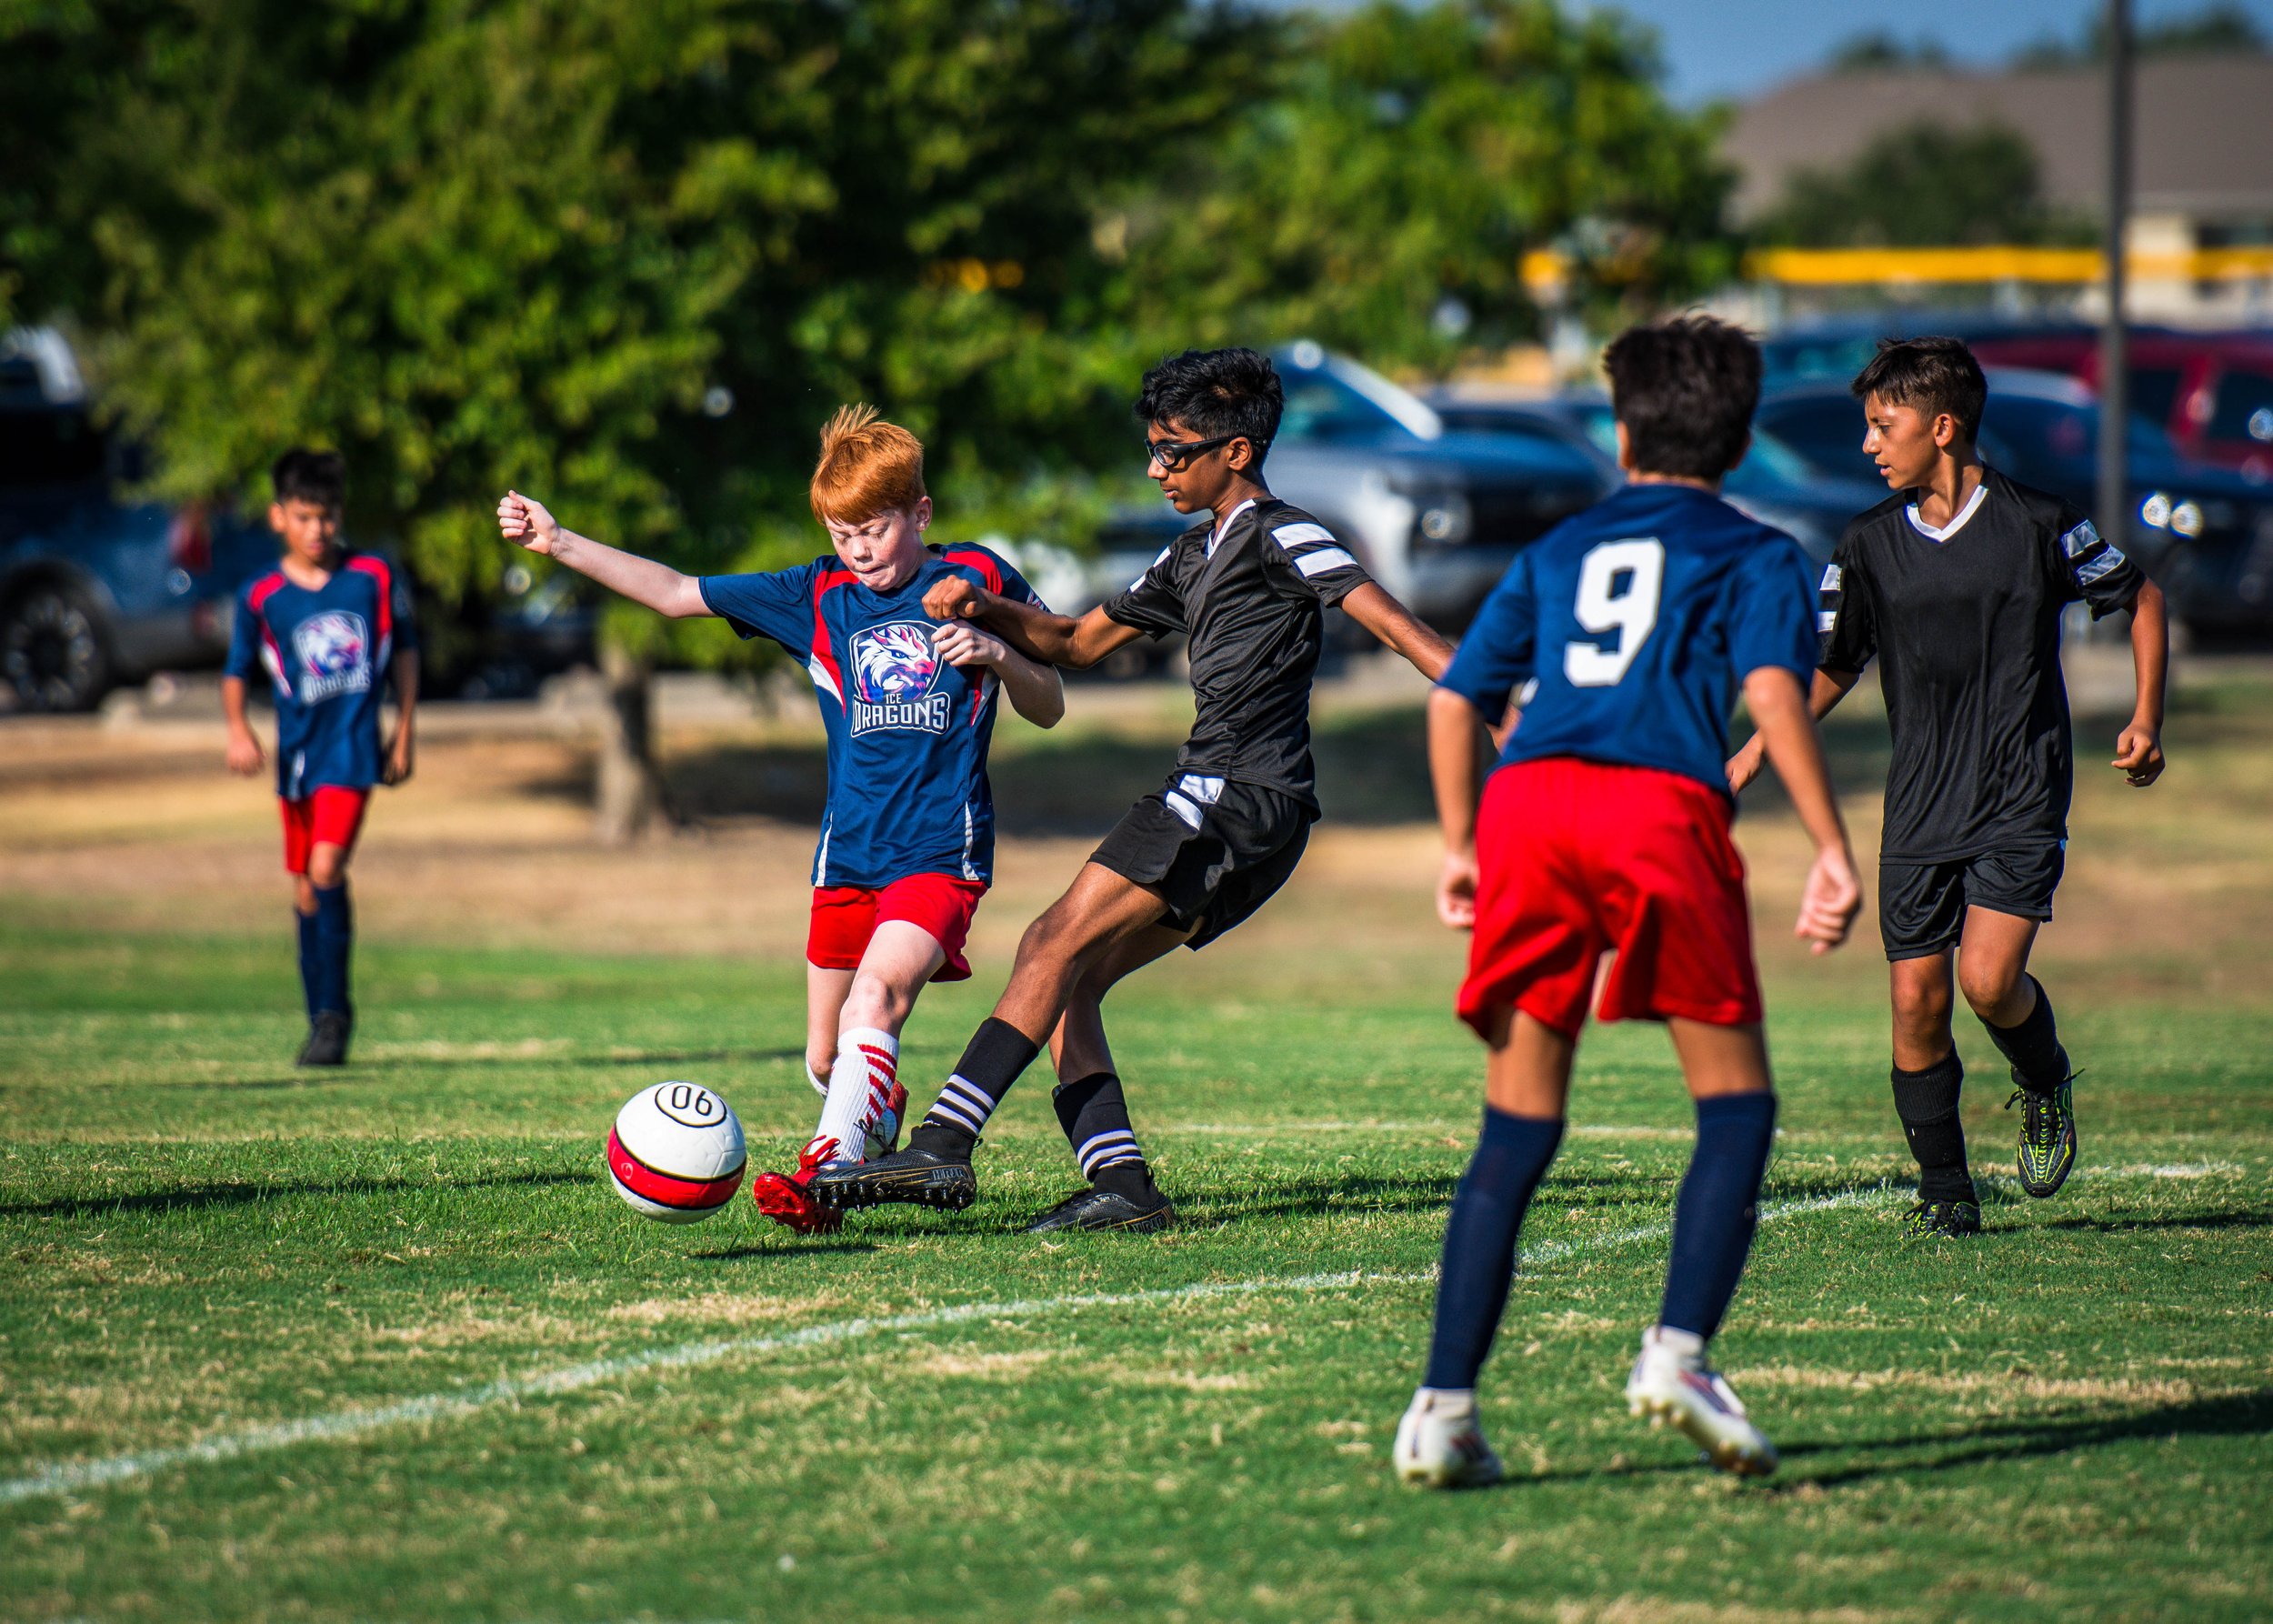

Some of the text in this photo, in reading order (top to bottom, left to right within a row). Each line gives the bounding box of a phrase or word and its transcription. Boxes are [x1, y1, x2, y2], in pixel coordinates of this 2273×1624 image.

[1563, 536, 1666, 687] 9
[853, 697, 946, 733] DRAGONS
[886, 693, 902, 705] ICE
[672, 1086, 713, 1116] 06
